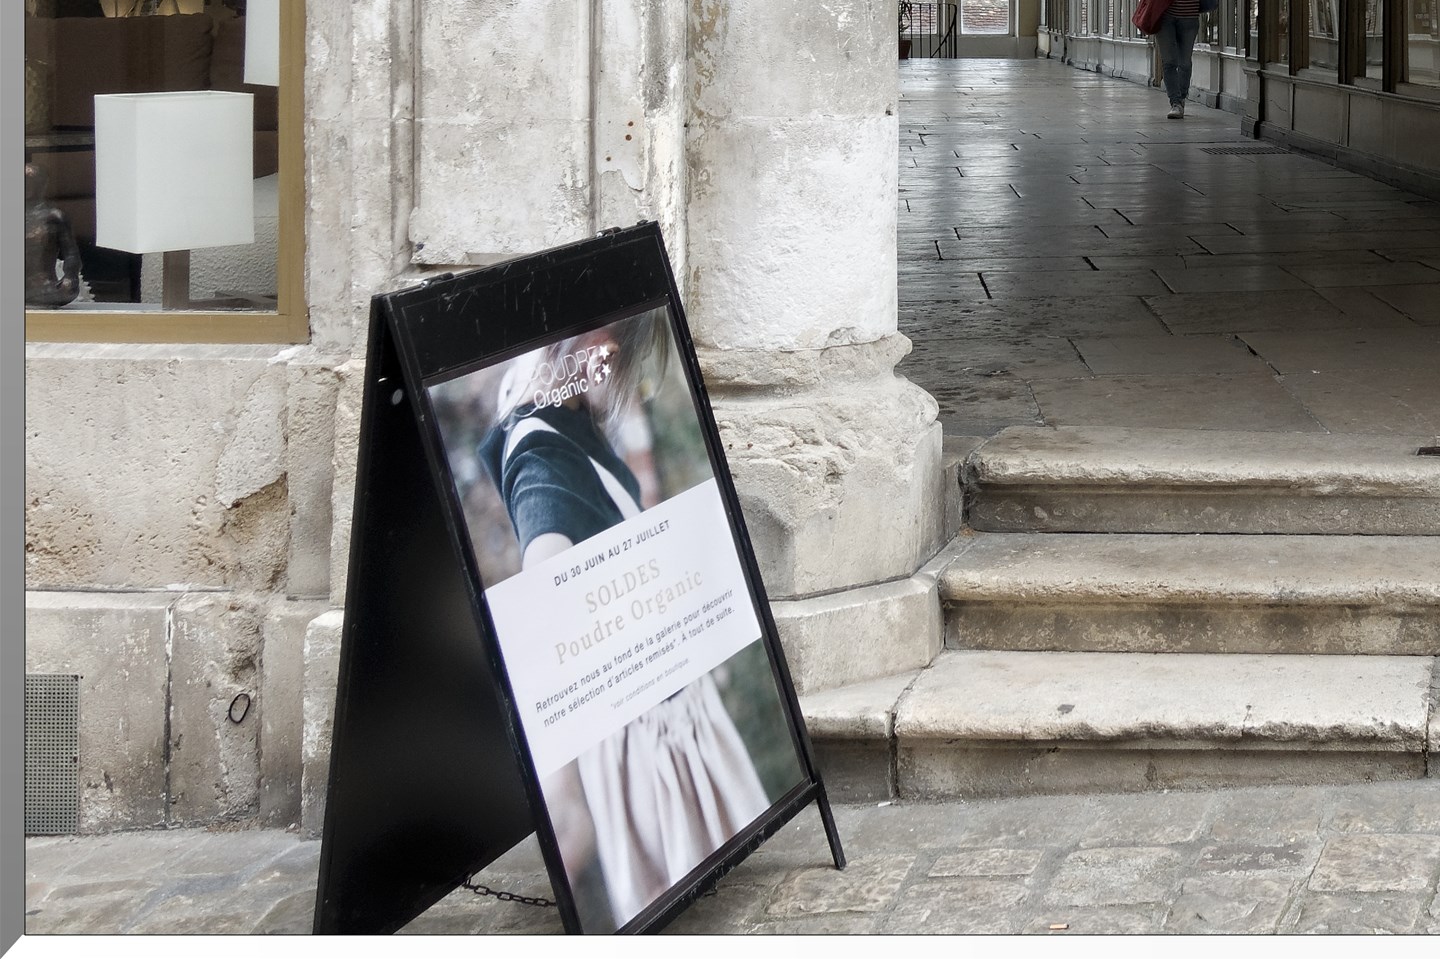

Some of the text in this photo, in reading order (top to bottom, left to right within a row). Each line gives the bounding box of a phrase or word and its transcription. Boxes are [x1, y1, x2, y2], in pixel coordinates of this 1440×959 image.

[533, 376, 589, 410] Organic
[554, 519, 671, 586] DU 30 JUIN AU 27 JUILLET
[585, 558, 661, 614] SOLDES
[554, 570, 704, 665] Poudre Organic
[535, 682, 579, 713] Retrouvez
[580, 668, 601, 687] nous
[602, 661, 613, 673] au
[614, 648, 633, 666] fond
[634, 642, 645, 654] de
[645, 637, 654, 647] la
[655, 620, 682, 643] galerie
[683, 609, 701, 626] pour
[543, 708, 567, 727] notre
[688, 624, 705, 639] tout
[705, 618, 715, 629] de
